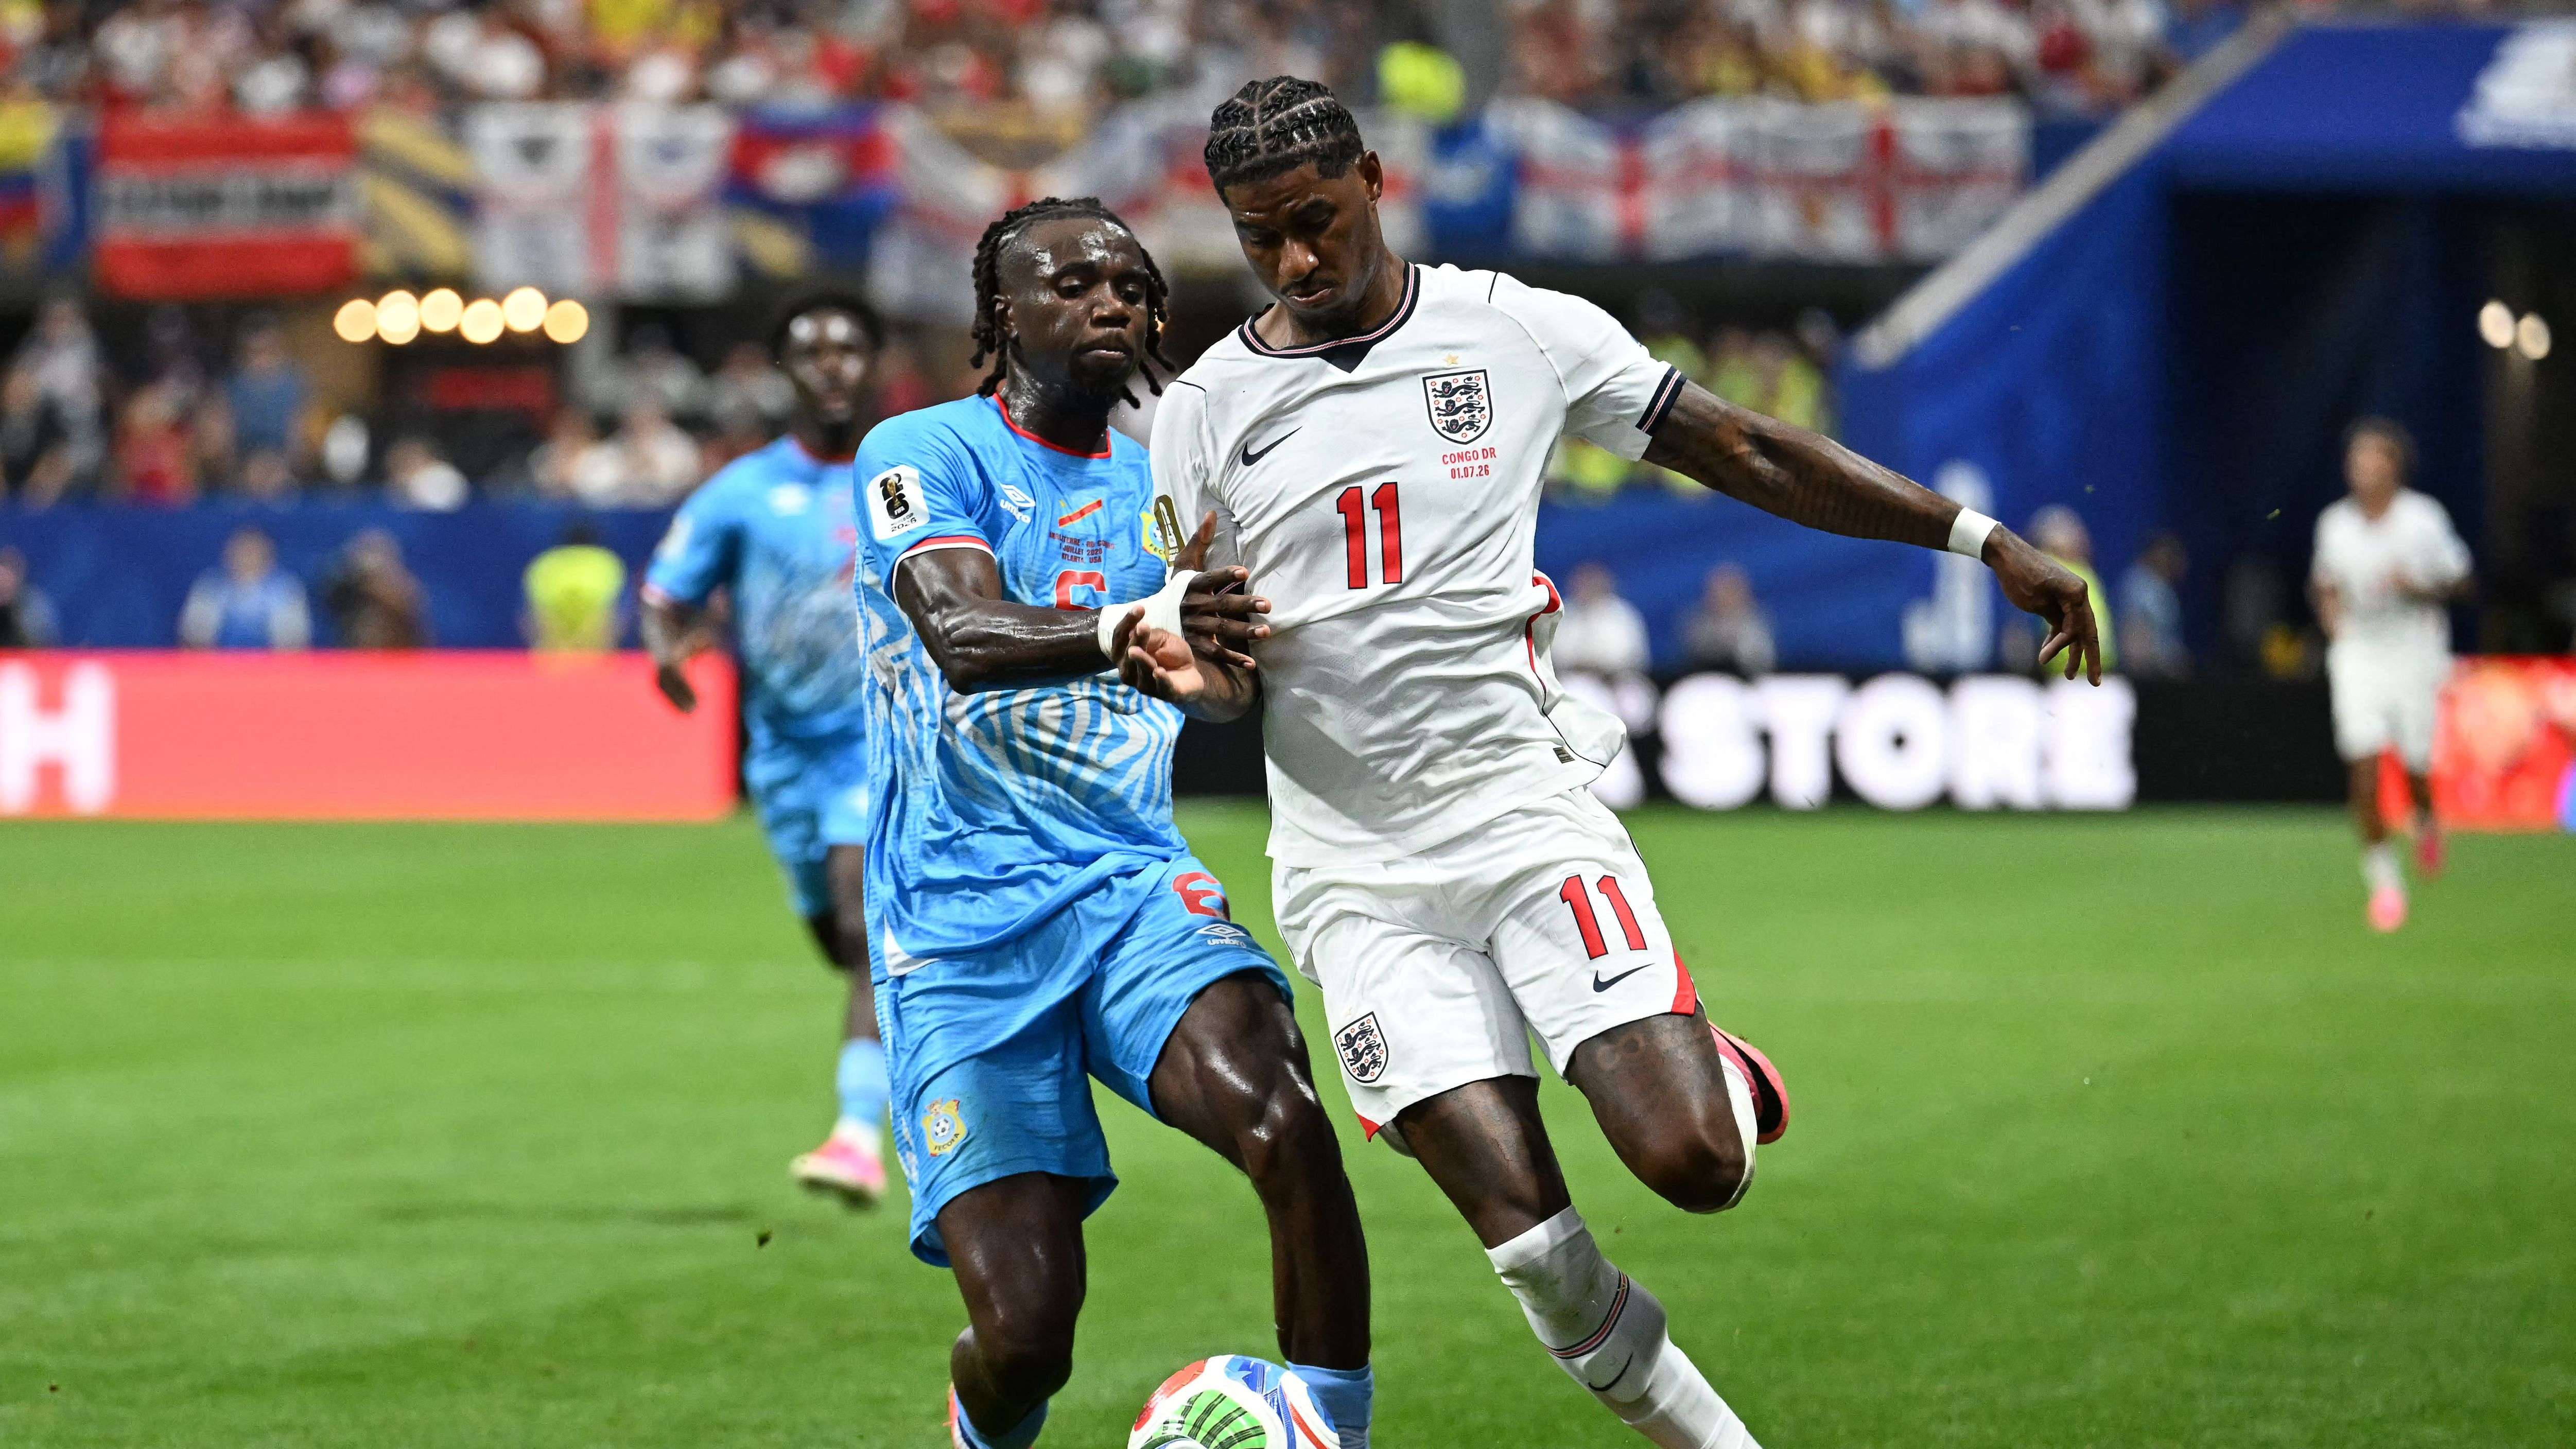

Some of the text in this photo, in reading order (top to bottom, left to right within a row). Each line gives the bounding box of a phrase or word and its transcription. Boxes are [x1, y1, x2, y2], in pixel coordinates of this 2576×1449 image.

[1442, 447, 1496, 464] CONGO DR
[1451, 465, 1489, 479] 01.07.26
[1000, 499, 1031, 523] umro
[1336, 482, 1402, 589] 11
[1657, 672, 2138, 810] STORE
[1560, 874, 1647, 960] 11
[1207, 937, 1247, 948] umbro
